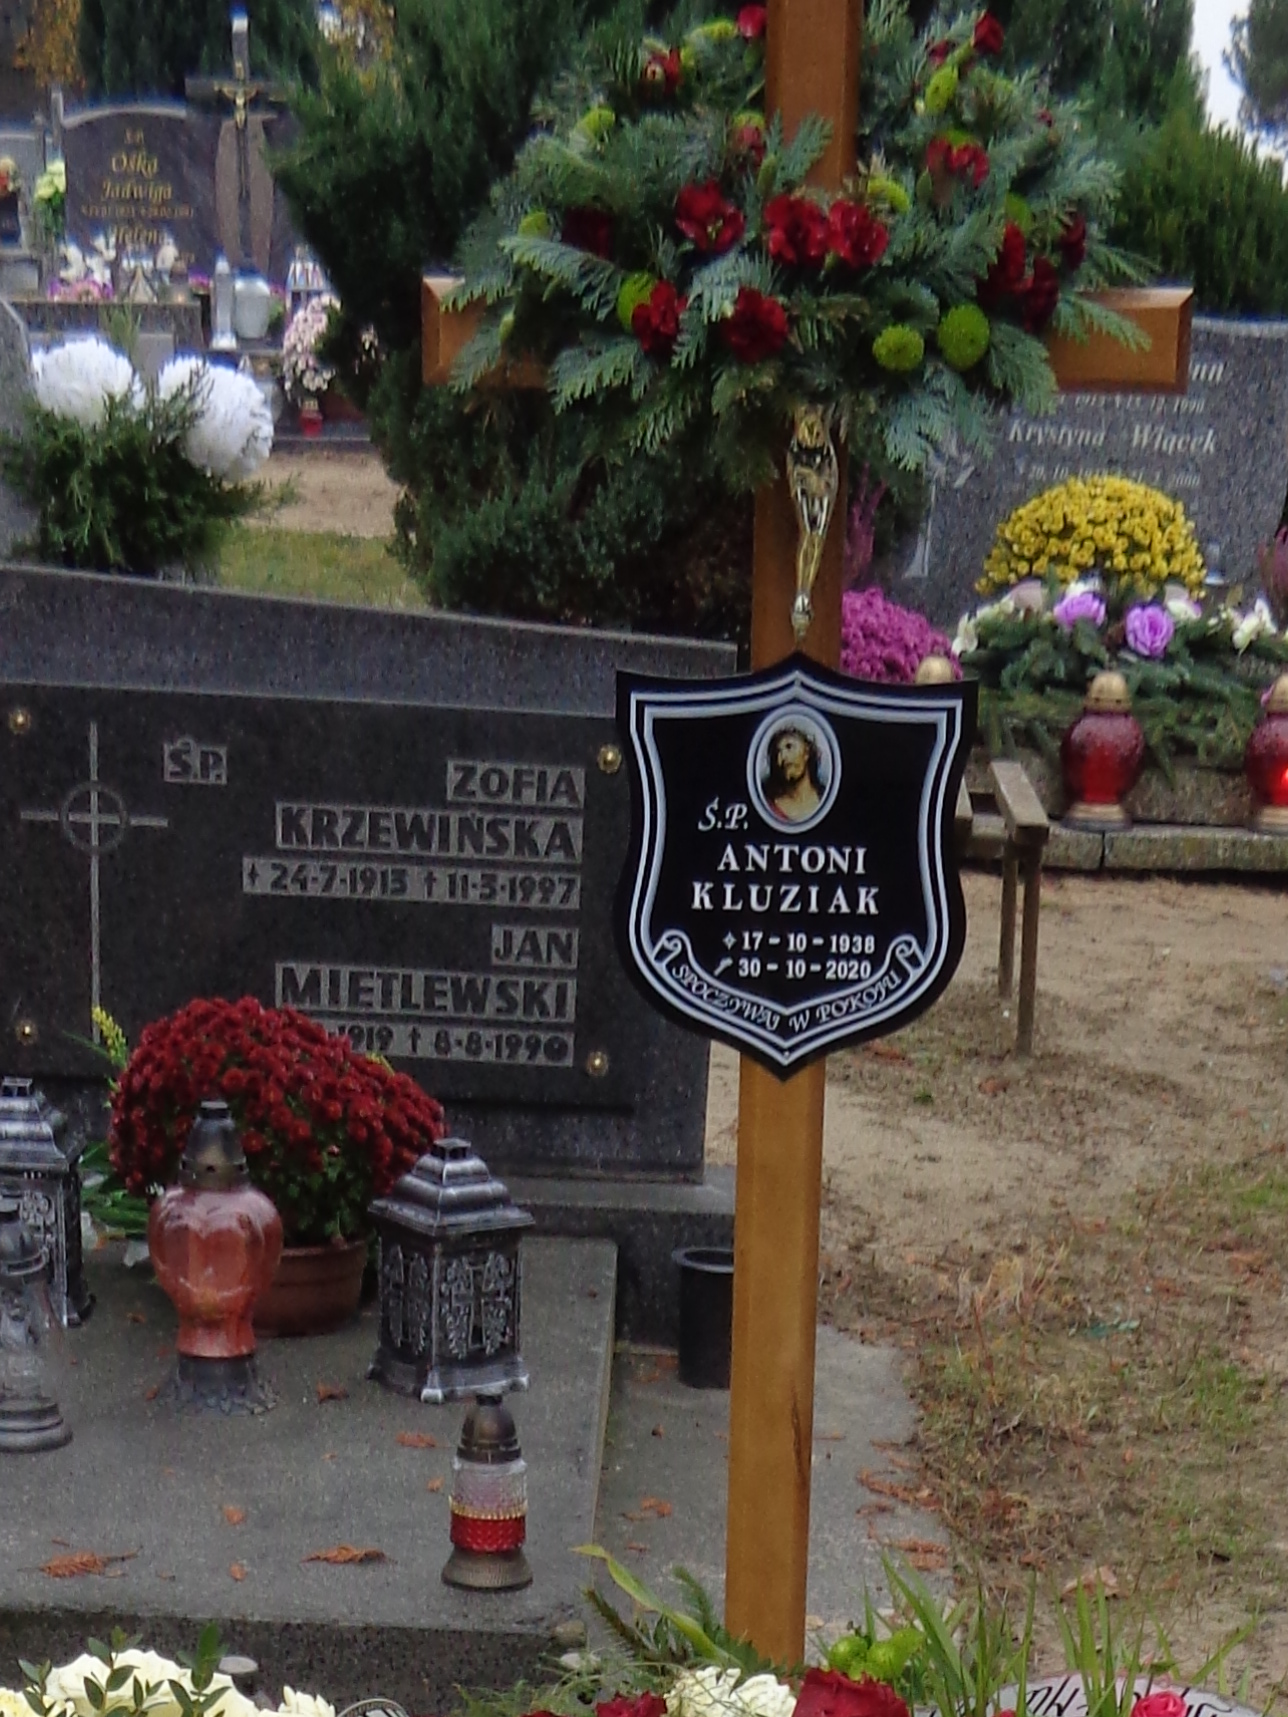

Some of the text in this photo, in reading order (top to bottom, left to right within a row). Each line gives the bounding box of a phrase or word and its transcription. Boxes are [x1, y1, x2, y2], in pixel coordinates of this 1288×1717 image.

[452, 765, 581, 802] ZOFIA
[279, 805, 577, 859] KRZEWIŃSKA
[697, 797, 749, 832] Ś.P.
[717, 844, 867, 875] ANTONI
[691, 881, 881, 915] KLUZIAK
[494, 929, 574, 965] JAN
[281, 966, 570, 1019] MIETLEWSKI
[671, 962, 904, 1034] SPOCZYWAJ W POKOJU
